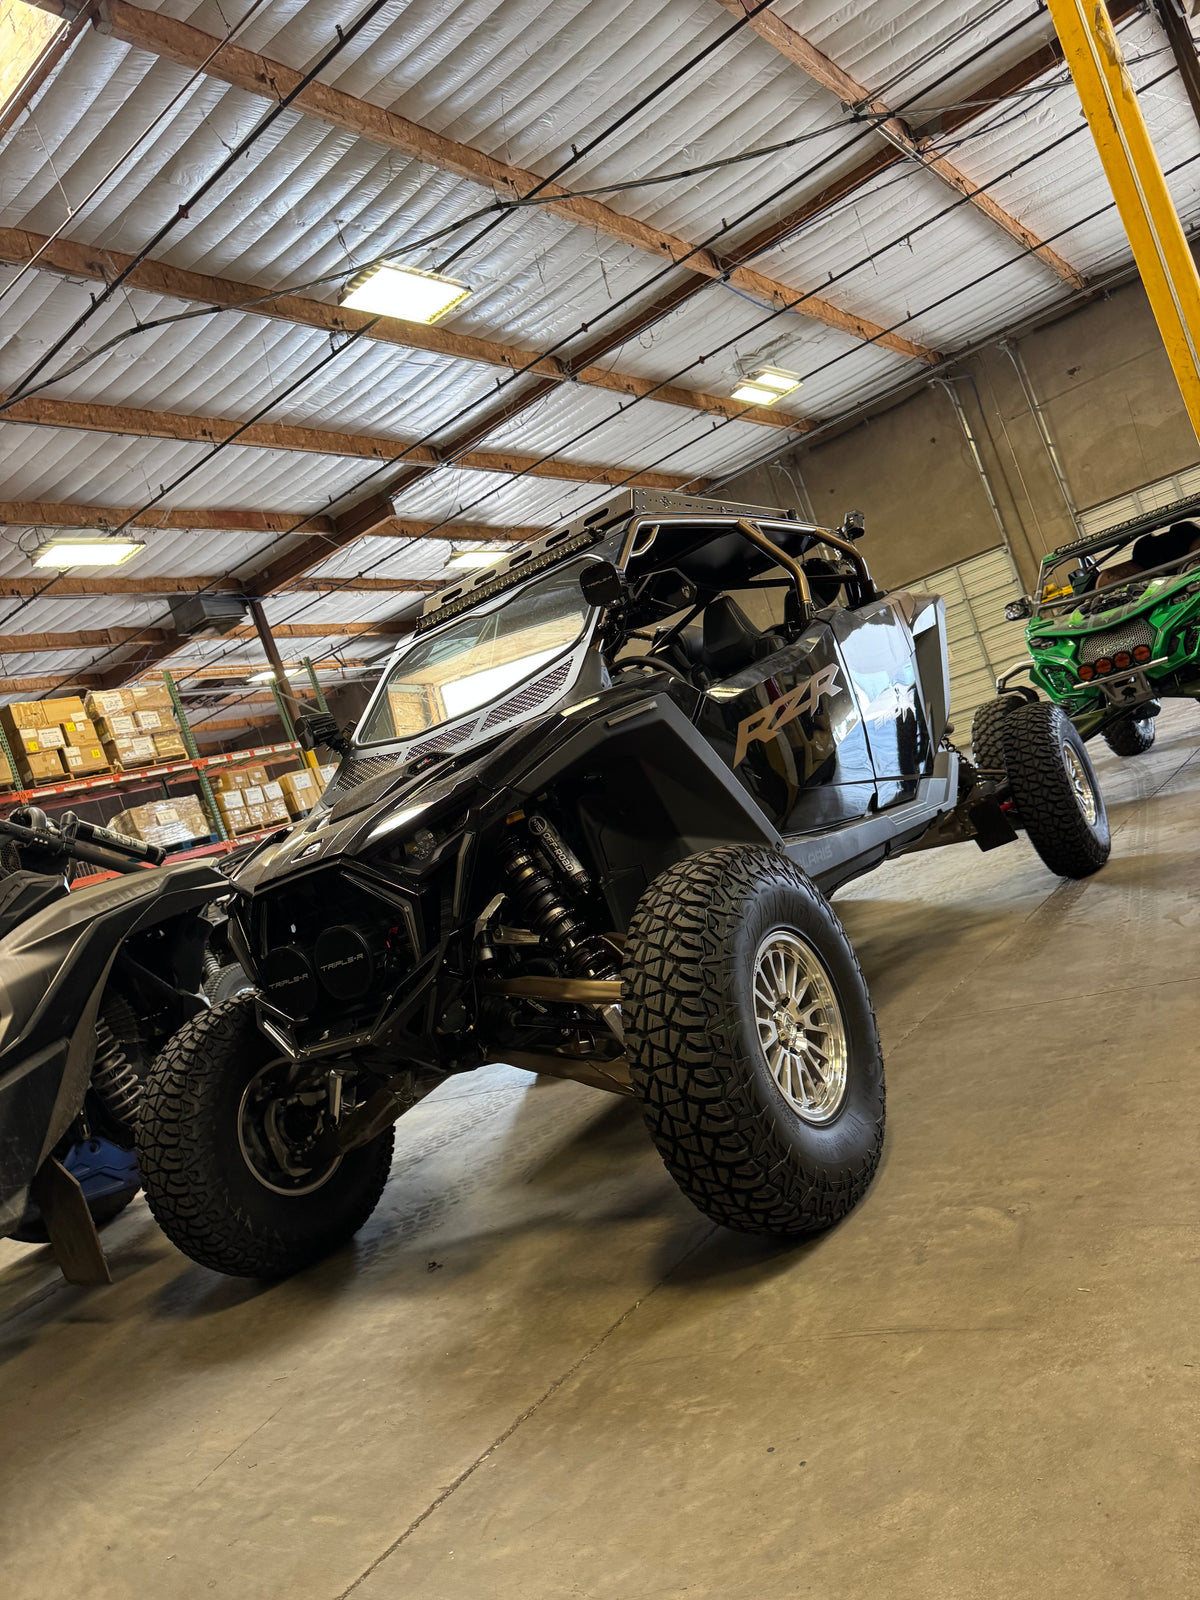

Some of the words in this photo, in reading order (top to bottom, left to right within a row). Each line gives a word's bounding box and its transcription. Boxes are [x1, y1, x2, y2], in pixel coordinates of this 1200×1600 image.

[733, 663, 843, 769] RZR
[320, 952, 364, 972] TRIPLE-R
[268, 972, 309, 990] TRIPLE-R
